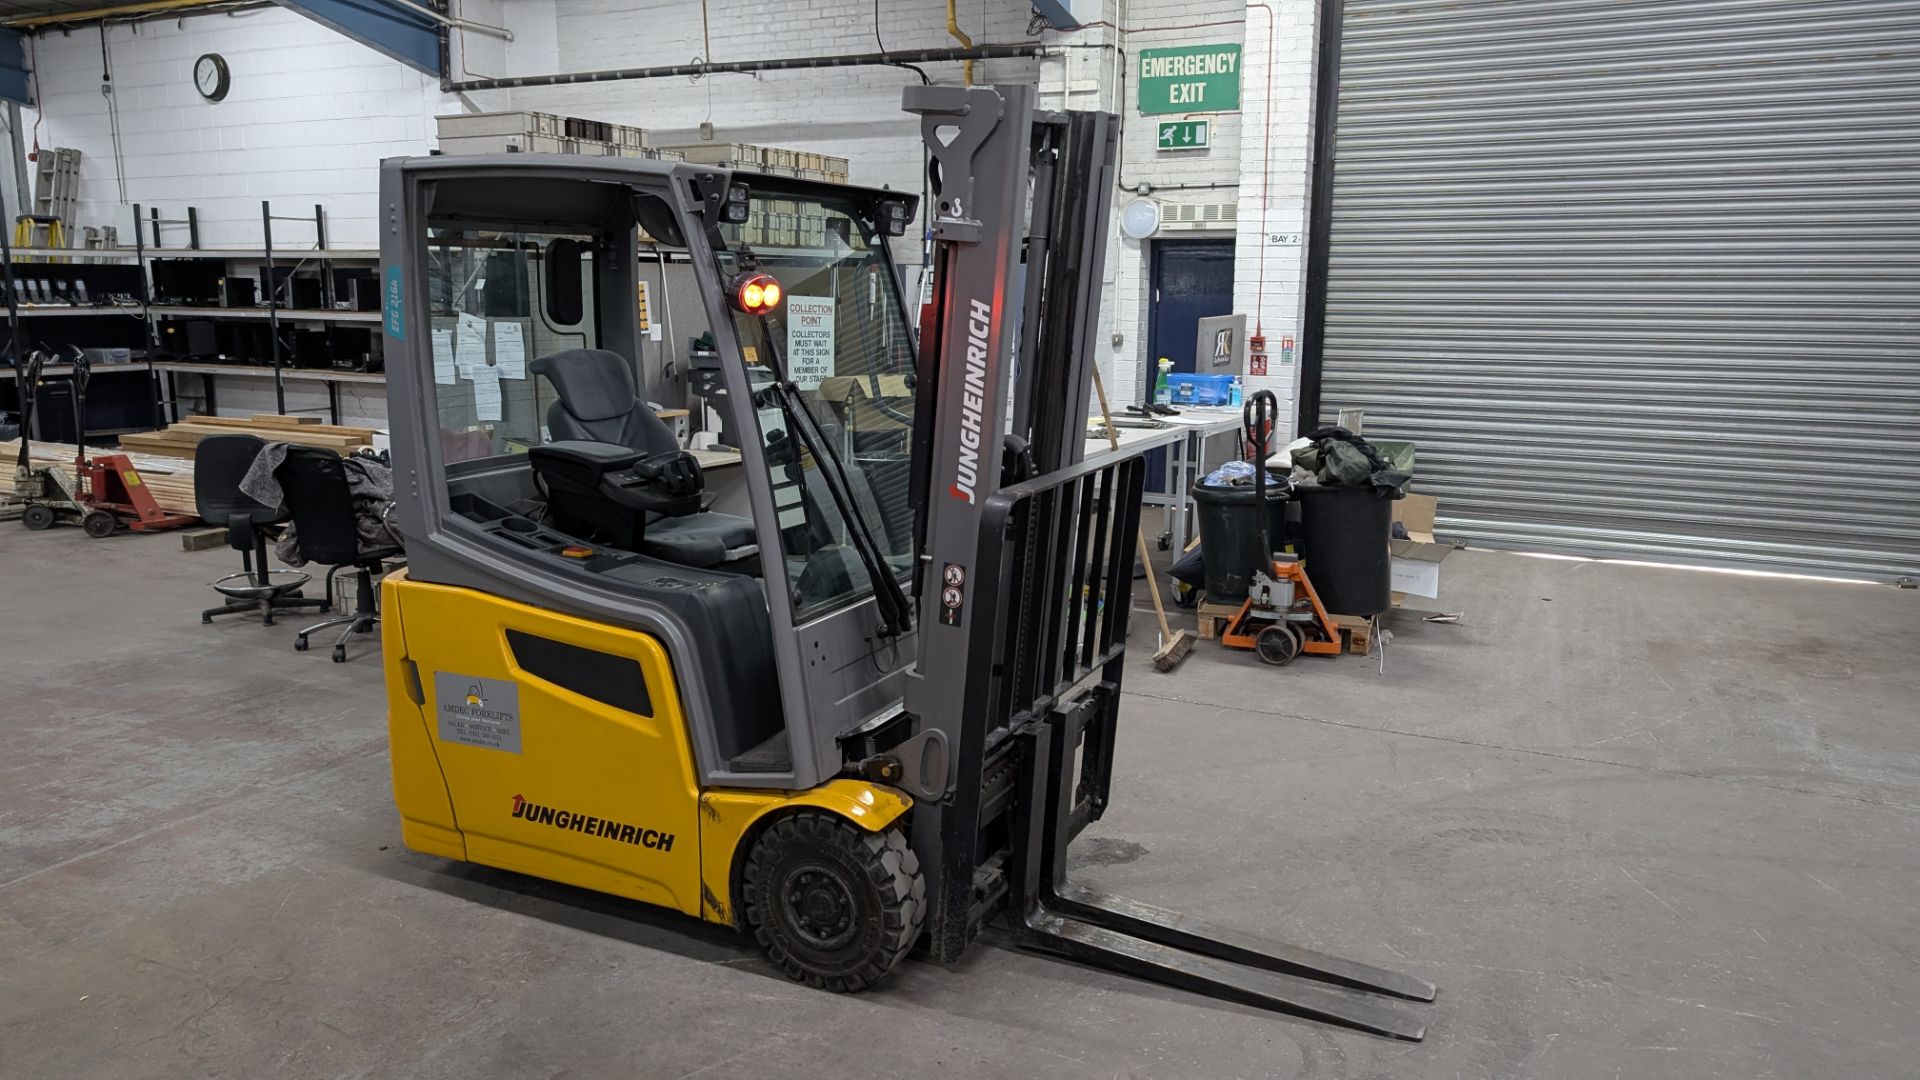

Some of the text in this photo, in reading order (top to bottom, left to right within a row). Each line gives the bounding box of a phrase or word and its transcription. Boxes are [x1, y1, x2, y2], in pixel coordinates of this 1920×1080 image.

[1141, 52, 1237, 78] EMERGENCY
[1169, 82, 1207, 104] EXIT
[1271, 235, 1298, 243] BAY 2
[789, 303, 833, 314] COLLECTION
[391, 310, 400, 333] EFG
[801, 315, 822, 325] POINT
[791, 330, 831, 339] COLLECTORS
[794, 340, 827, 348] MUST WAIT
[792, 349, 830, 357] AT THIS SIGN
[794, 367, 828, 375] MEMBER OF
[795, 375, 807, 383] OUR
[950, 298, 991, 505] JUNGHEINRICH
[443, 704, 470, 714] AMDEC
[472, 708, 513, 721] FORKLIFTS
[511, 794, 675, 852] JUNGHEINRICH
